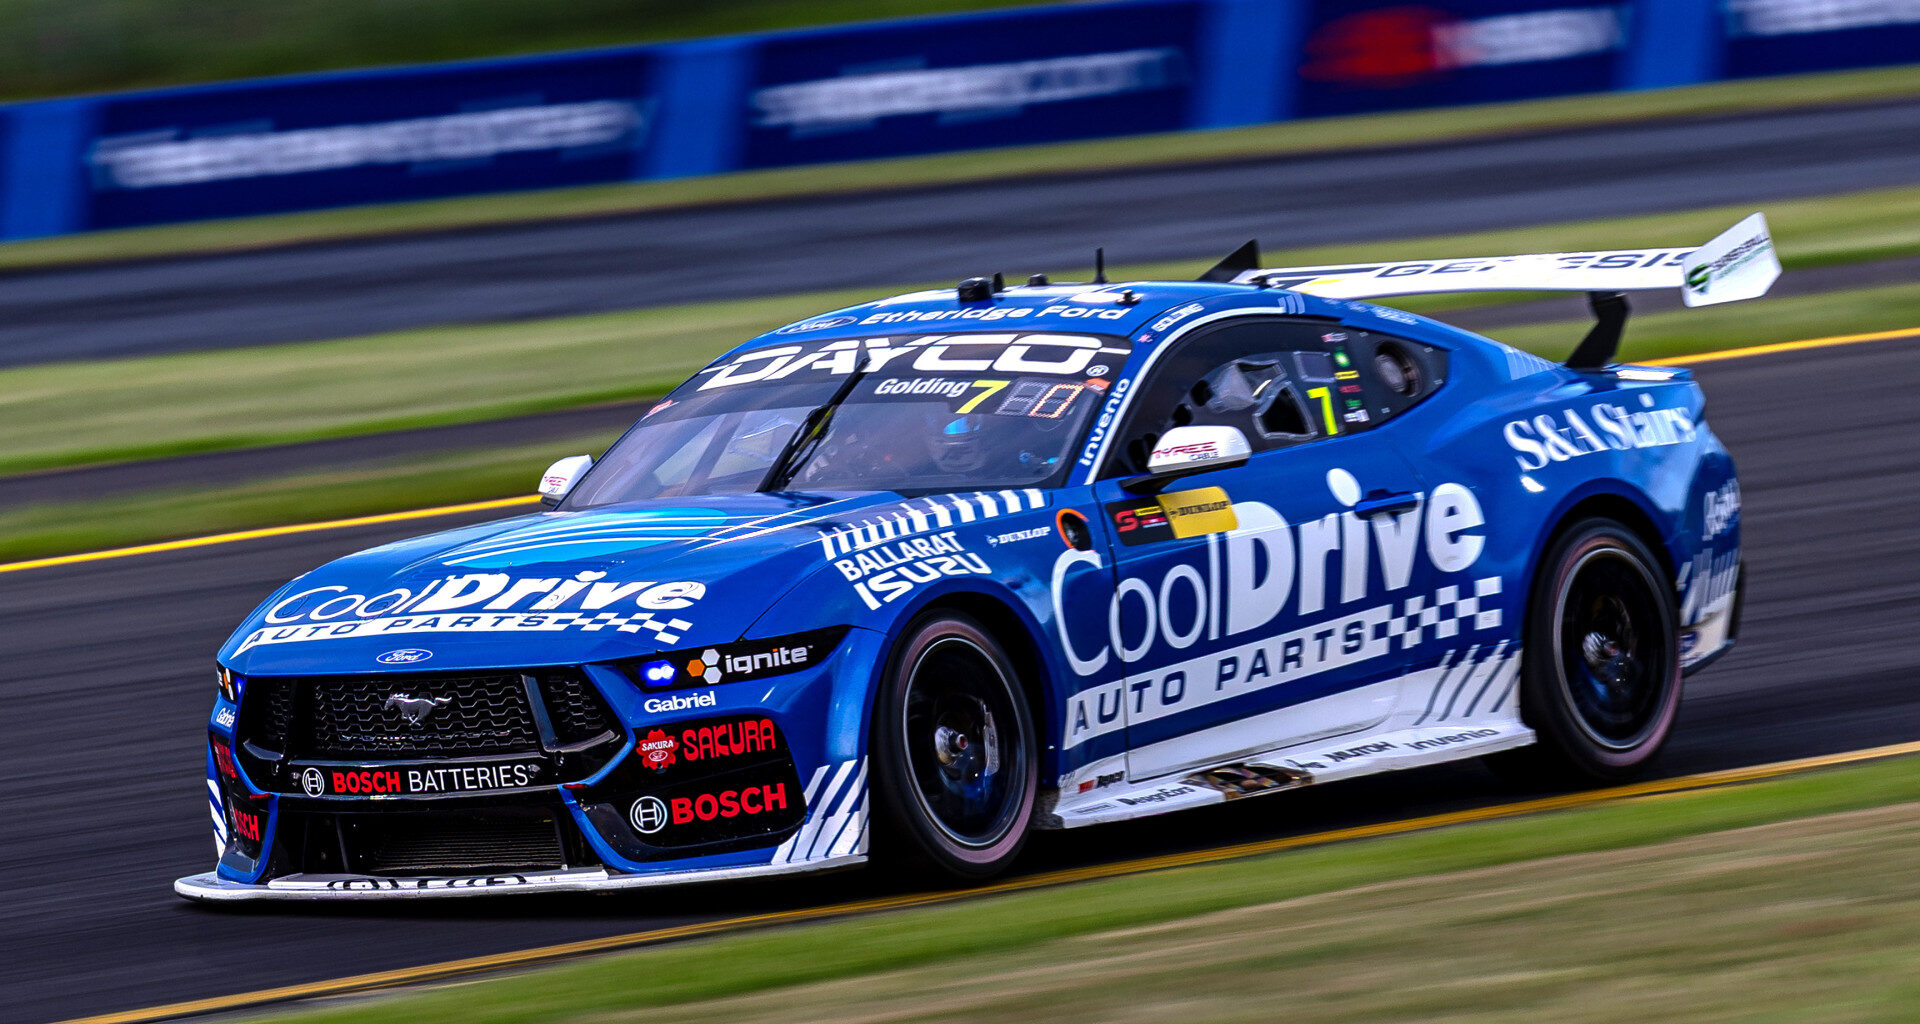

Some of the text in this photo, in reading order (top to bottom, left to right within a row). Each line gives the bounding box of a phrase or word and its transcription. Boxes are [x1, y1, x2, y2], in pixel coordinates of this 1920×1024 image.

[1375, 251, 1691, 278] GEESIS
[858, 305, 1132, 325] Etheridge Ford
[697, 334, 1132, 391] DAYCO
[875, 378, 1010, 414] Golding 7
[1306, 386, 1338, 435] 7
[1503, 393, 1697, 472] S&A Stairs
[1179, 501, 1230, 516] DUNLOP
[998, 527, 1051, 544] DUNLOP
[834, 531, 965, 582] BALLARAT
[854, 552, 992, 611] ISUZU
[264, 571, 707, 624] CoolDrive
[248, 615, 548, 648] AUTO PARTS
[384, 650, 424, 664] Ford
[725, 646, 808, 674] ignite
[1073, 620, 1366, 735] AUTO PARTS
[644, 690, 717, 713] Gabriel
[641, 740, 674, 751] SAKURA
[682, 718, 776, 761] SAKURA
[1324, 742, 1398, 762] MUTOH
[1404, 729, 1501, 750] invenio
[333, 765, 529, 792] BOSCH BATTERIES
[671, 783, 787, 824] BOSCH
